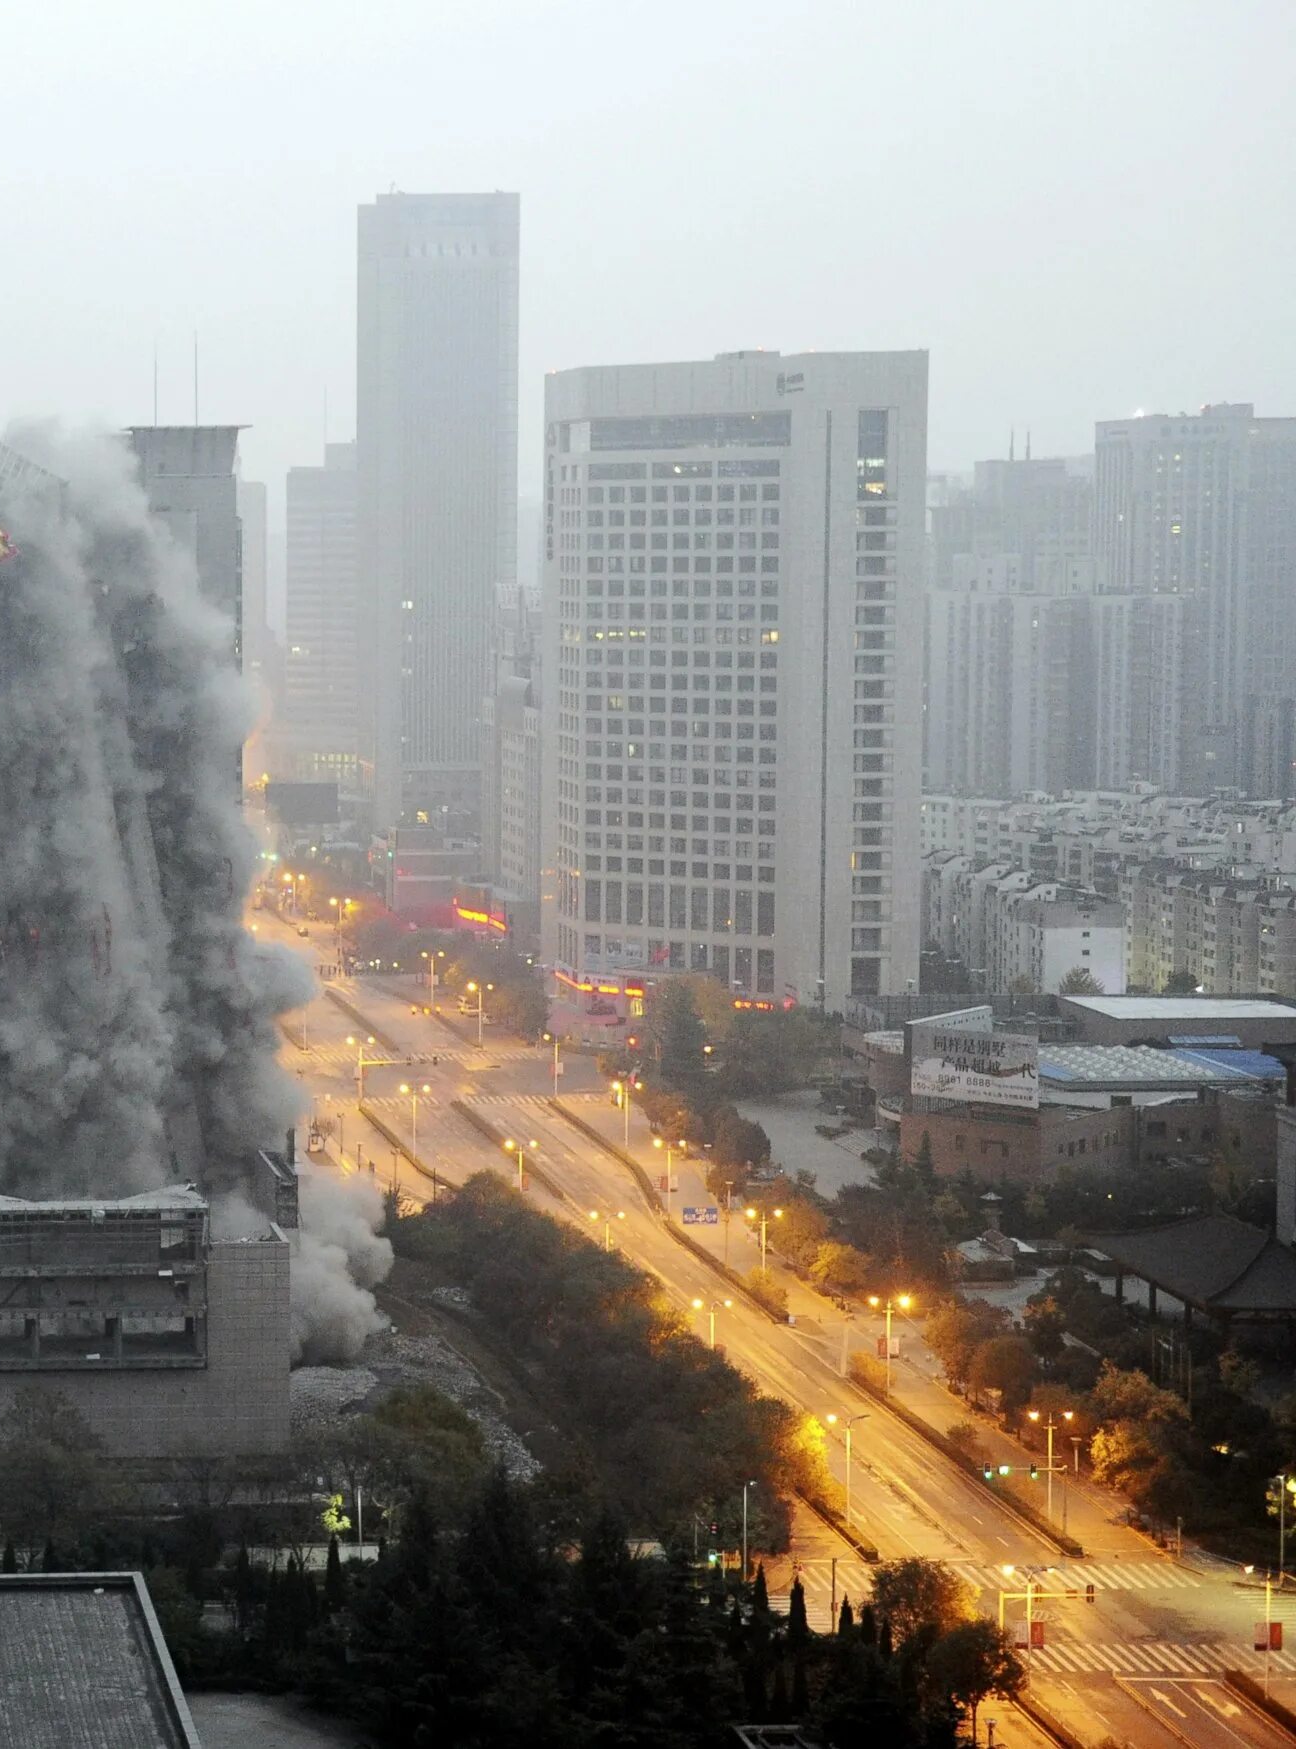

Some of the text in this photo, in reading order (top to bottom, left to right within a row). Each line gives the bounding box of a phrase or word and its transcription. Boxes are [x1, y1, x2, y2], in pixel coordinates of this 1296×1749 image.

[934, 1035, 1006, 1057] 同样是别墅
